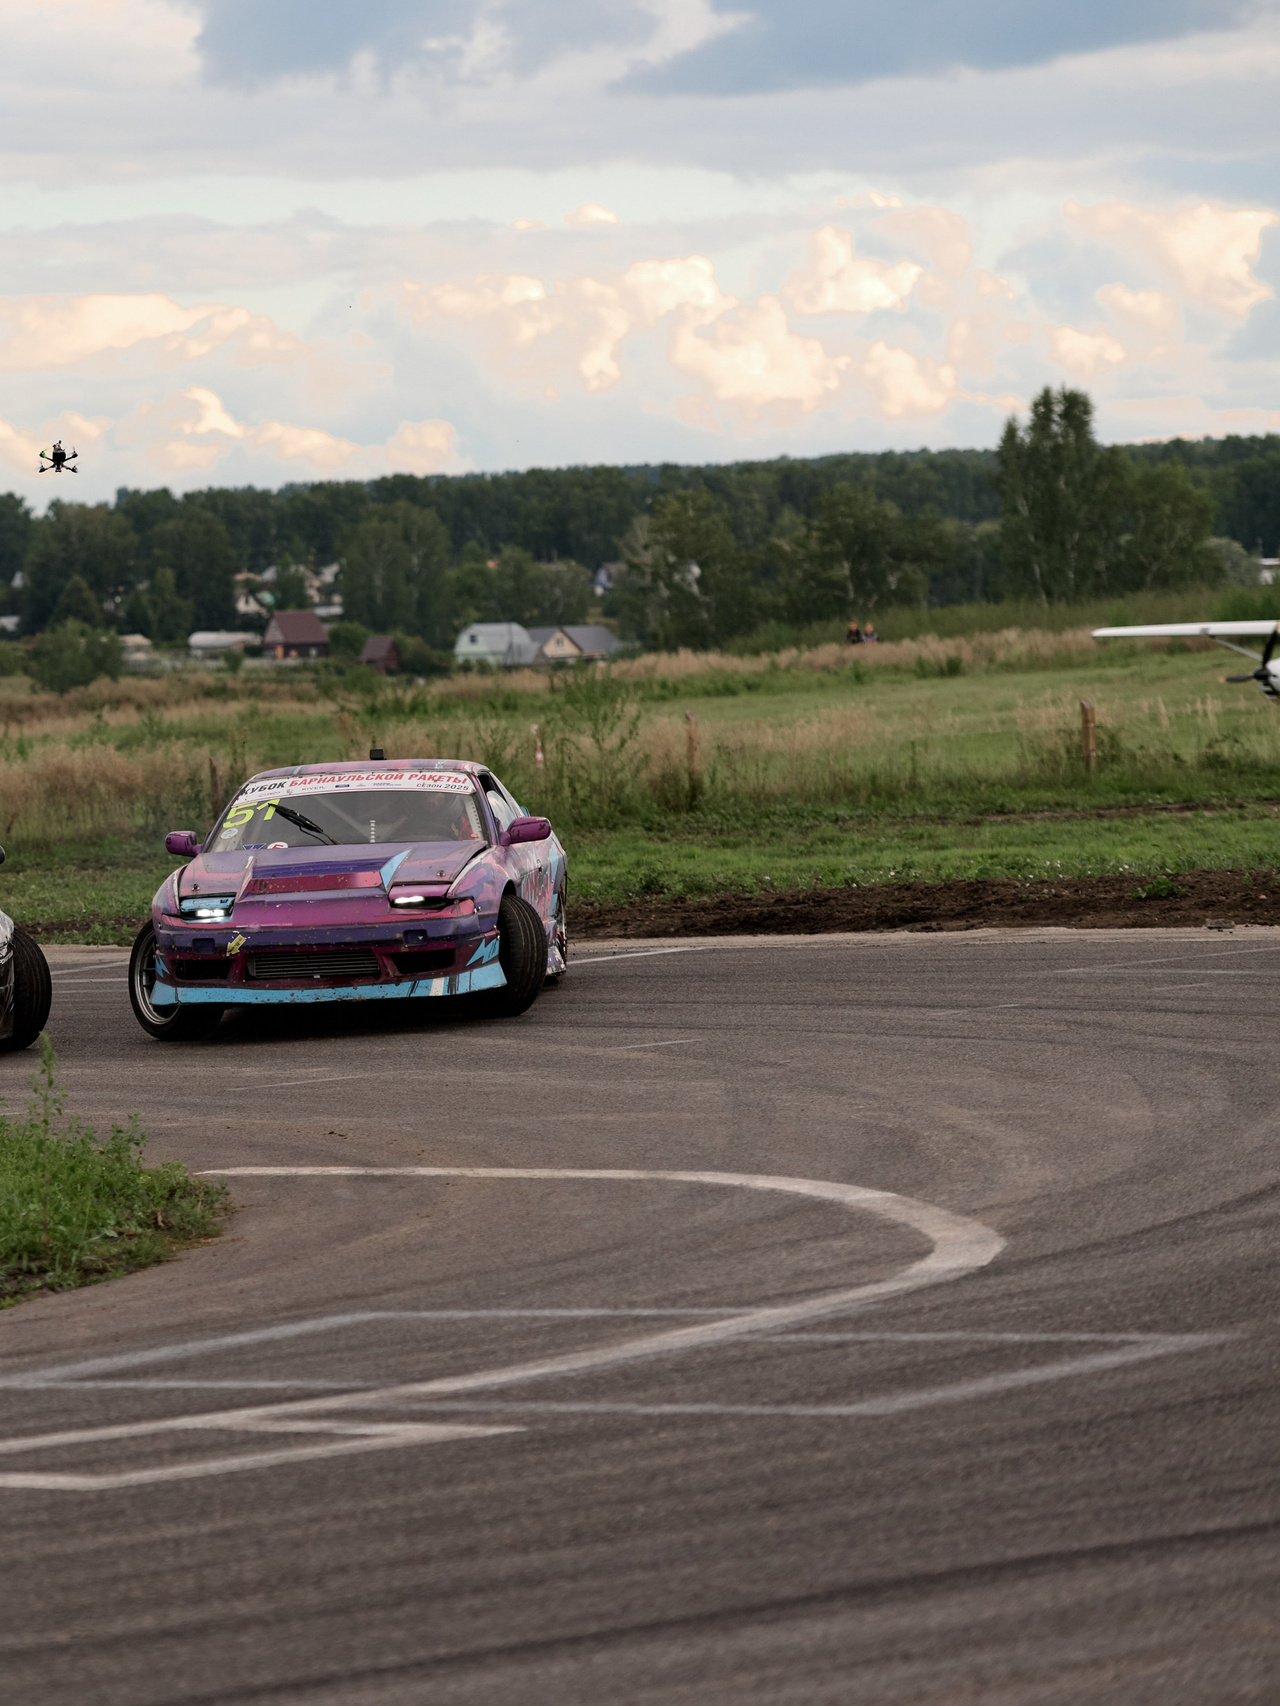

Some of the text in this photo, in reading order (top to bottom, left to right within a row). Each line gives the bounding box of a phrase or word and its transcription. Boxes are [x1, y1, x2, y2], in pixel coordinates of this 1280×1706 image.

[243, 781, 287, 796] КУБОК
[288, 773, 405, 787] БАРНАУЛЬСКОЙ
[408, 773, 468, 784] РАКЕТЫ
[443, 783, 469, 791] 2025
[222, 798, 281, 829] 51
